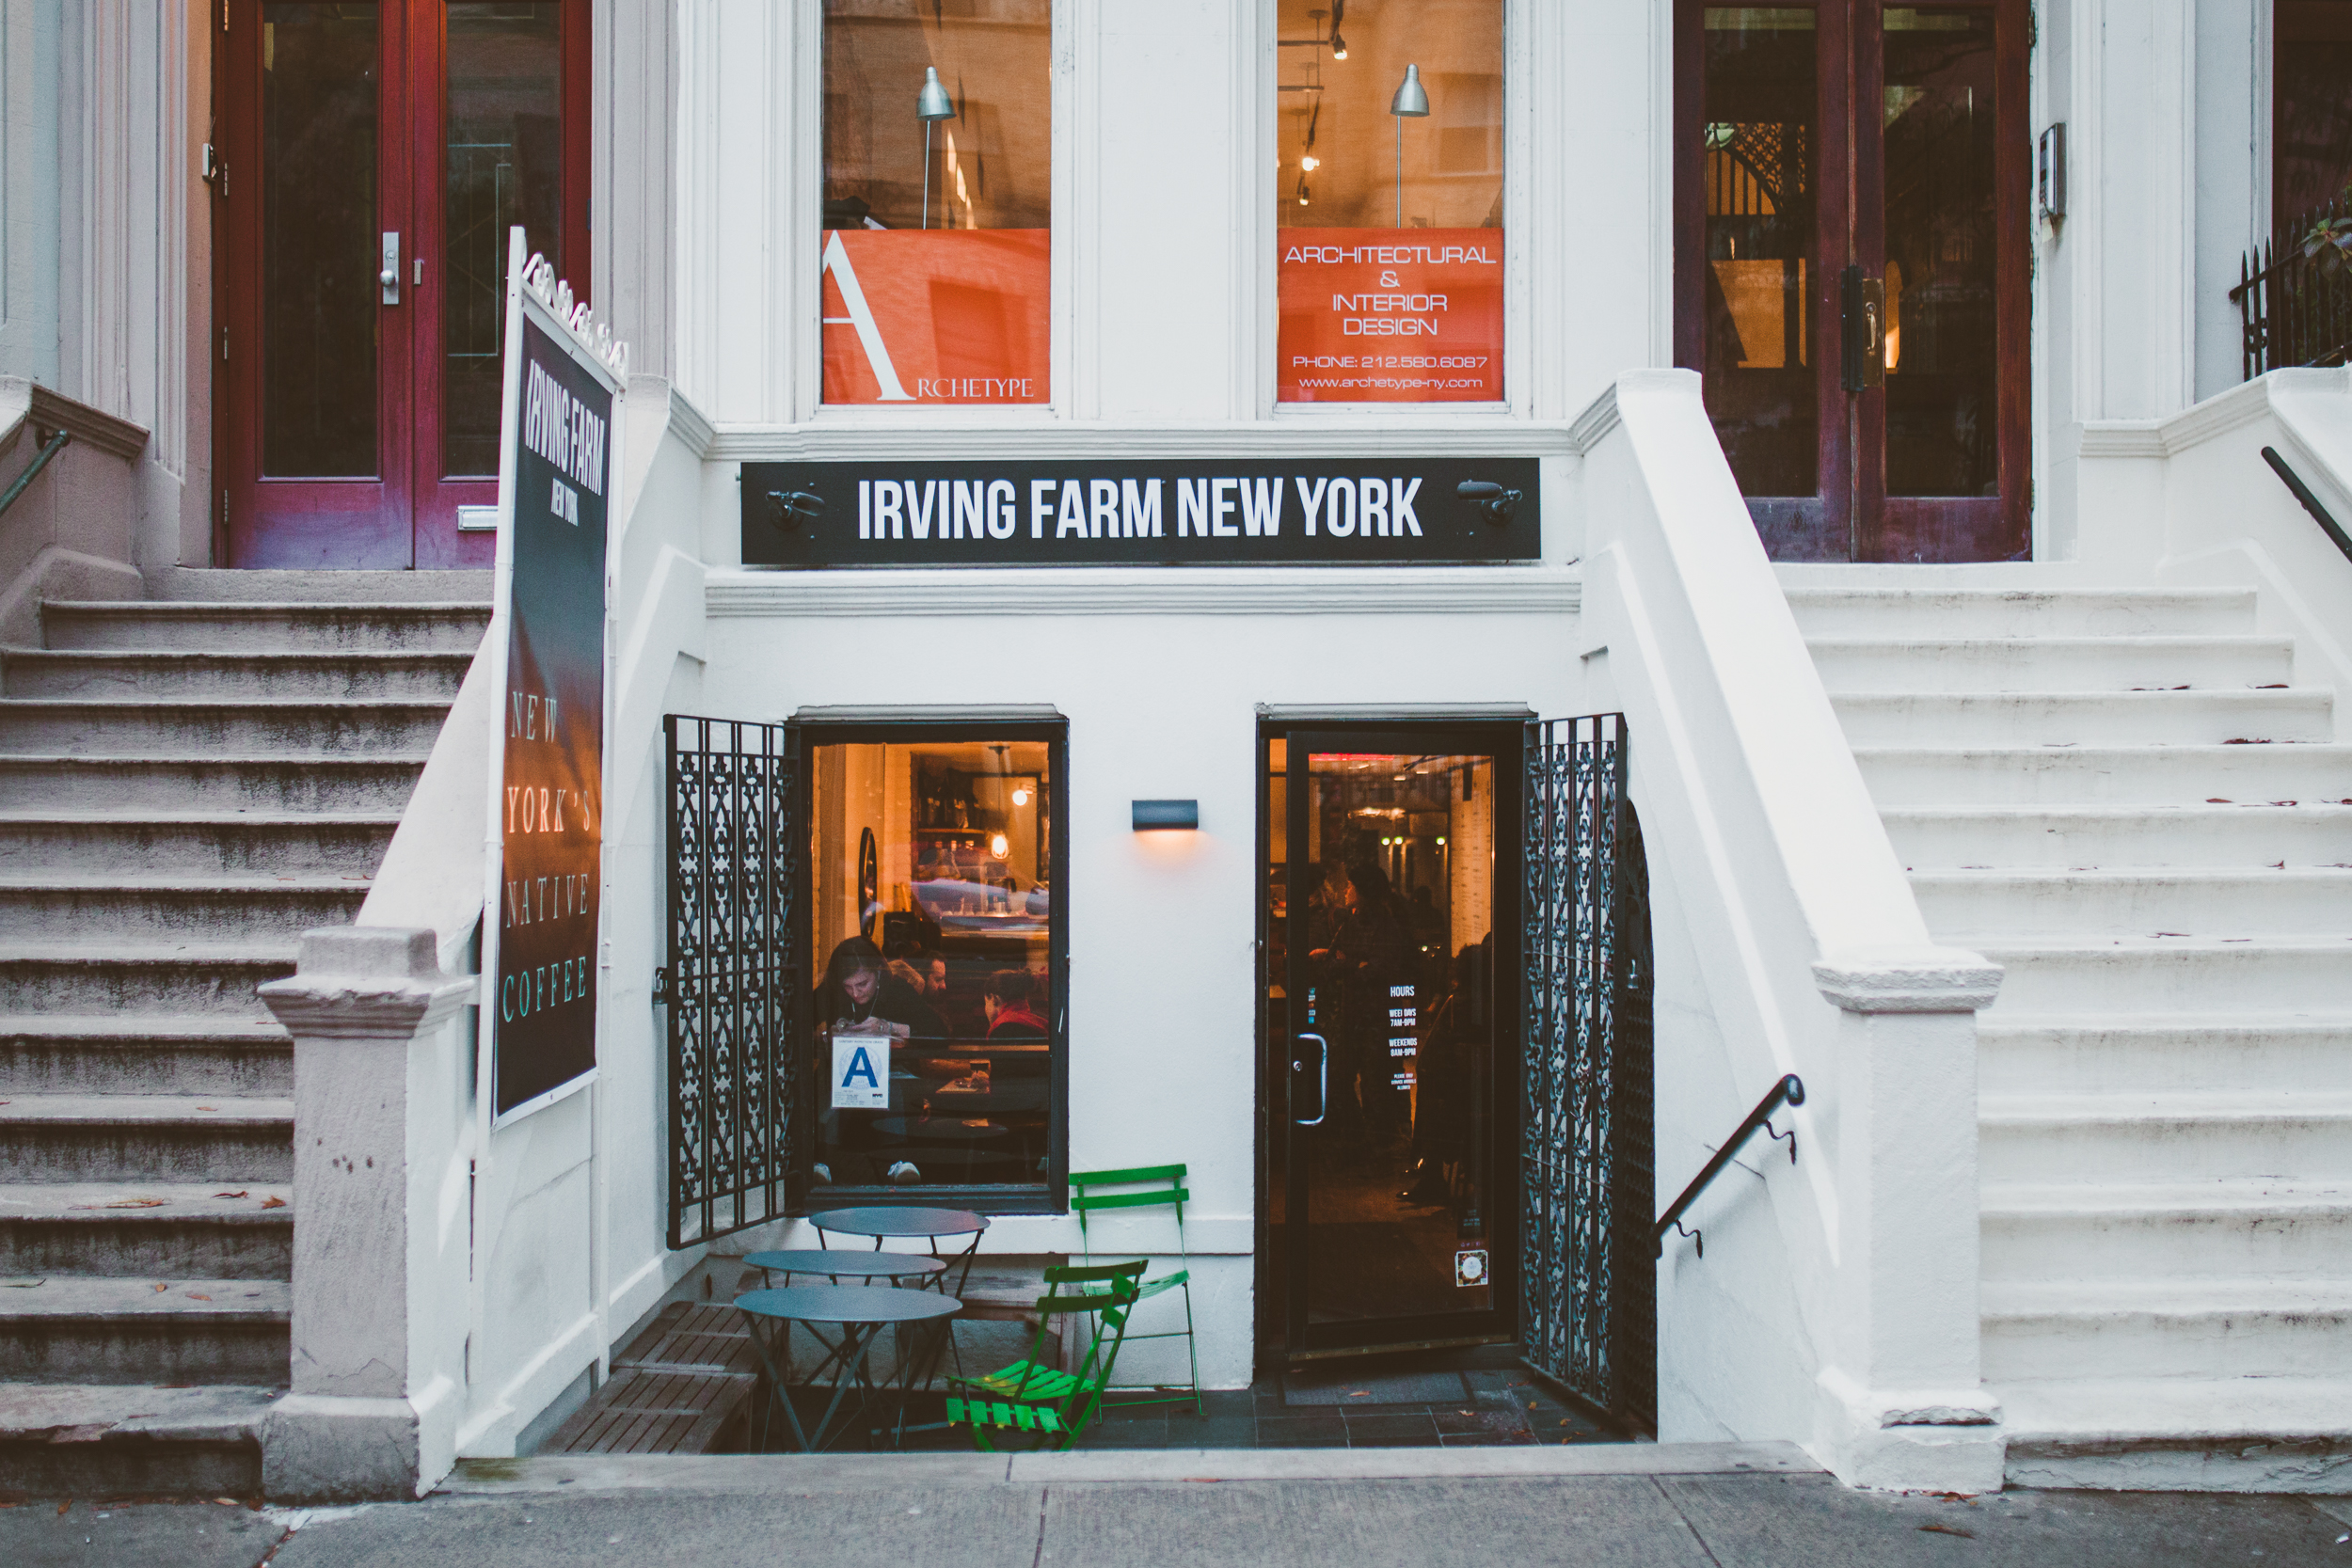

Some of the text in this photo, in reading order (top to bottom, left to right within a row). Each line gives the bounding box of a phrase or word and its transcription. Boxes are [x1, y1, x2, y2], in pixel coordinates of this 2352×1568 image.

[1284, 246, 1497, 263] ARCHITECTURAL
[1380, 271, 1400, 288] &
[1333, 294, 1447, 311] INTERIOR
[1343, 319, 1438, 336] DESIGN
[1293, 356, 1487, 368] PHONE: 212.580.6087
[1299, 376, 1483, 389] www.archetype-ny.com
[525, 358, 605, 496] IRVING FARM
[550, 477, 564, 518] NEW
[858, 477, 1423, 540] IRVING FARM NEW YORK
[511, 691, 558, 743] NEW
[508, 786, 591, 833] YORK'S
[506, 873, 589, 928] NATIVE
[502, 956, 586, 1023] COFFEE
[1390, 985, 1415, 997] HOURS
[1389, 1037, 1418, 1047] WEEKENDS
[841, 1047, 879, 1087] A
